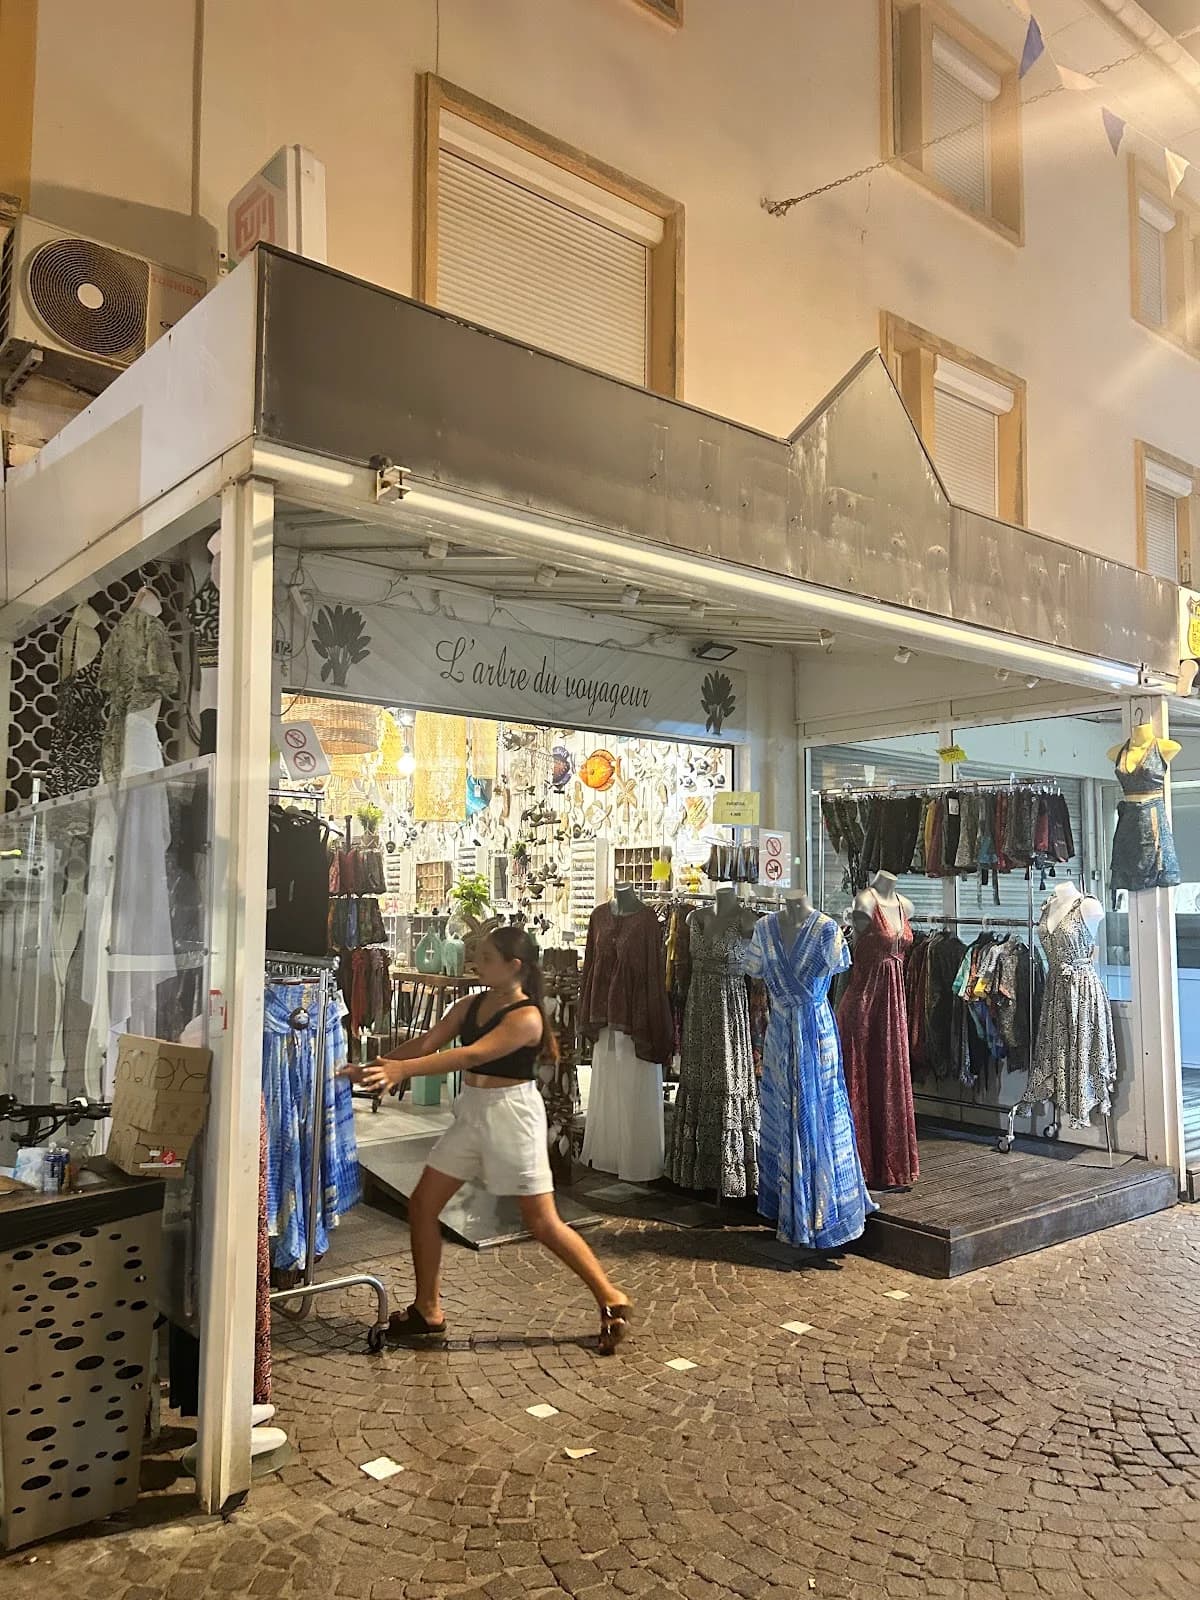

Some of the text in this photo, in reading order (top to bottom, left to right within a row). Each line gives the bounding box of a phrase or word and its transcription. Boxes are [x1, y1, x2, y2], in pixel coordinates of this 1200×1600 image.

[152, 275, 201, 298] TOSHIBA
[435, 636, 651, 718] L'arbre du voyageur
